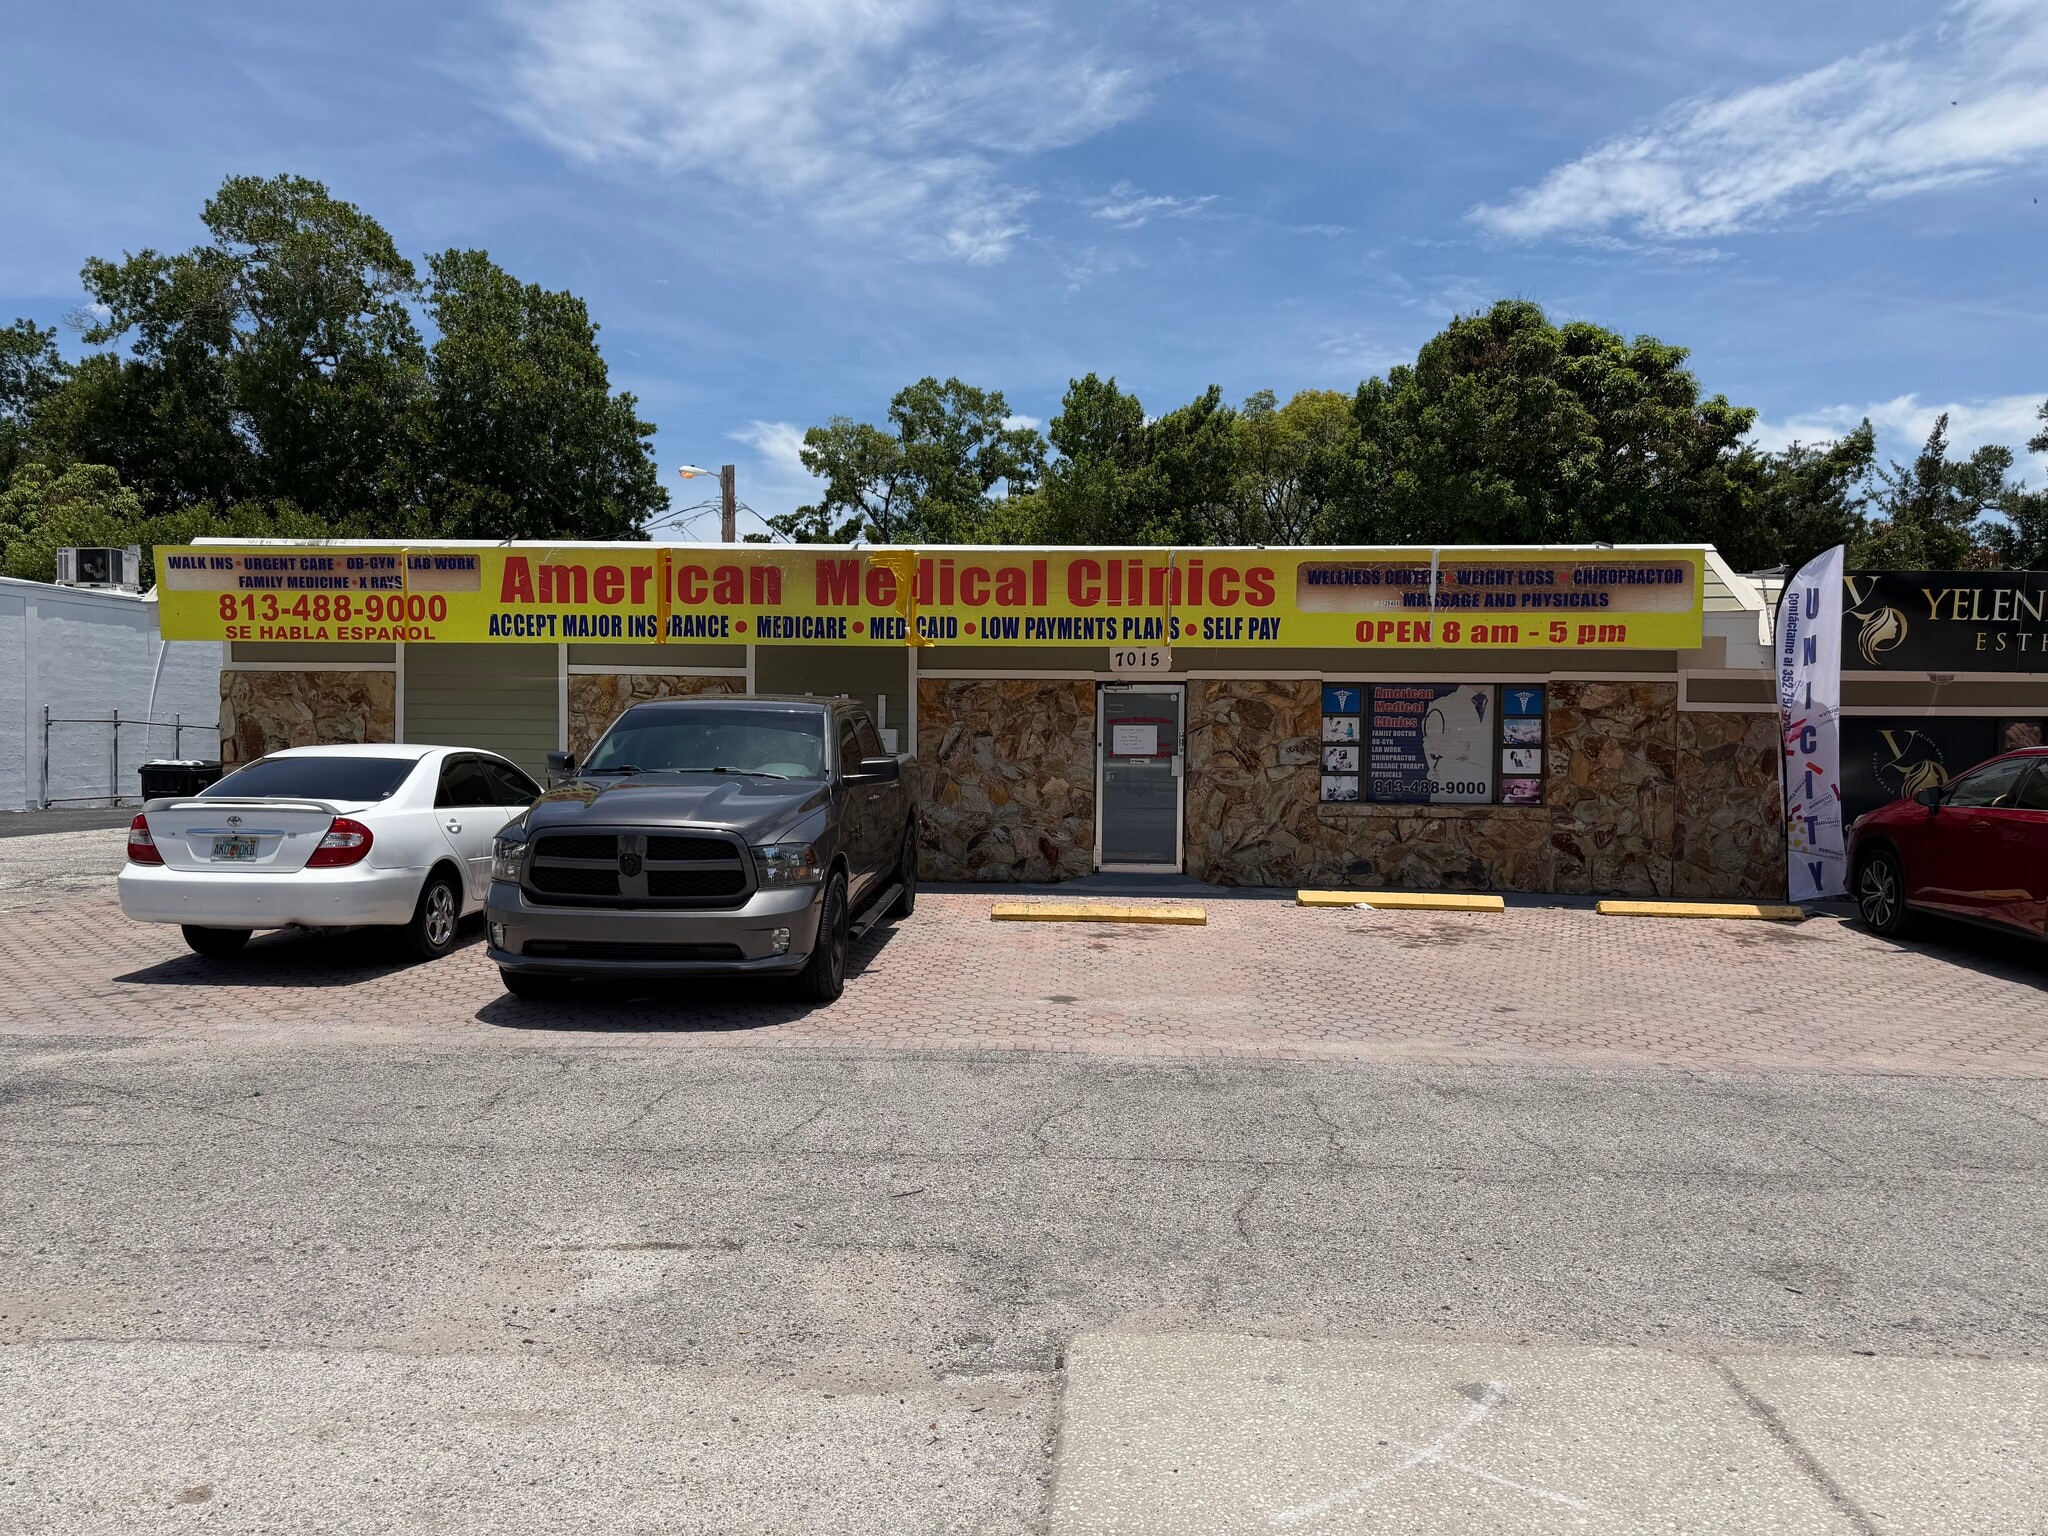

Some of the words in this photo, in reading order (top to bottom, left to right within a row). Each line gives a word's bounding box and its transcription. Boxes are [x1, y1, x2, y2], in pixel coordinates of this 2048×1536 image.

[168, 556, 206, 569] WALK
[210, 557, 233, 569] INS
[244, 557, 297, 570] URGENT
[300, 557, 334, 571] CARE
[346, 557, 395, 570] OB-GYN
[407, 557, 431, 570] LAB
[434, 557, 475, 570] WORK
[239, 575, 283, 588] FAMILY
[287, 575, 349, 589] MEDICINE
[359, 576, 367, 588] X
[371, 575, 403, 589] RAYS
[815, 559, 1047, 606] Medical
[1067, 559, 1275, 606] Clinics
[1307, 570, 1381, 585] WELENESS
[1456, 570, 1514, 586] WEIGHT
[1518, 570, 1555, 586] LOSS
[1573, 569, 1683, 585] CHIROPRACTOR
[219, 593, 447, 622] 813-488-9000
[1403, 592, 1480, 608] MASSAGE
[1483, 593, 1517, 608] AND
[1521, 592, 1610, 608] PHYSICALS
[1921, 588, 2048, 622] YELEN
[489, 613, 557, 637] ACCEPT
[562, 614, 621, 638] MAJOR
[757, 615, 847, 640] MEDICARE
[870, 616, 958, 640] MEDCAID
[981, 616, 1020, 640] LOW
[1025, 616, 1117, 641] PAYMENTS
[1122, 616, 1180, 640] PLANS
[1203, 617, 1243, 640] SELF
[1249, 617, 1281, 641] PAY
[1784, 593, 1800, 655] Contáctame
[225, 625, 252, 640] SE
[260, 626, 328, 640] HABLA
[337, 625, 436, 641] ESPAÑOL
[1355, 620, 1430, 643] OPEN
[1442, 621, 1461, 644] 8
[1470, 624, 1519, 644] am
[1549, 621, 1568, 644] 5
[1576, 624, 1627, 646] pm
[1115, 651, 1160, 668] 7015
[1374, 687, 1434, 700] American
[1374, 701, 1425, 713] Medical
[1374, 716, 1418, 728] Clinics
[1374, 779, 1487, 795] 813-488-9000
